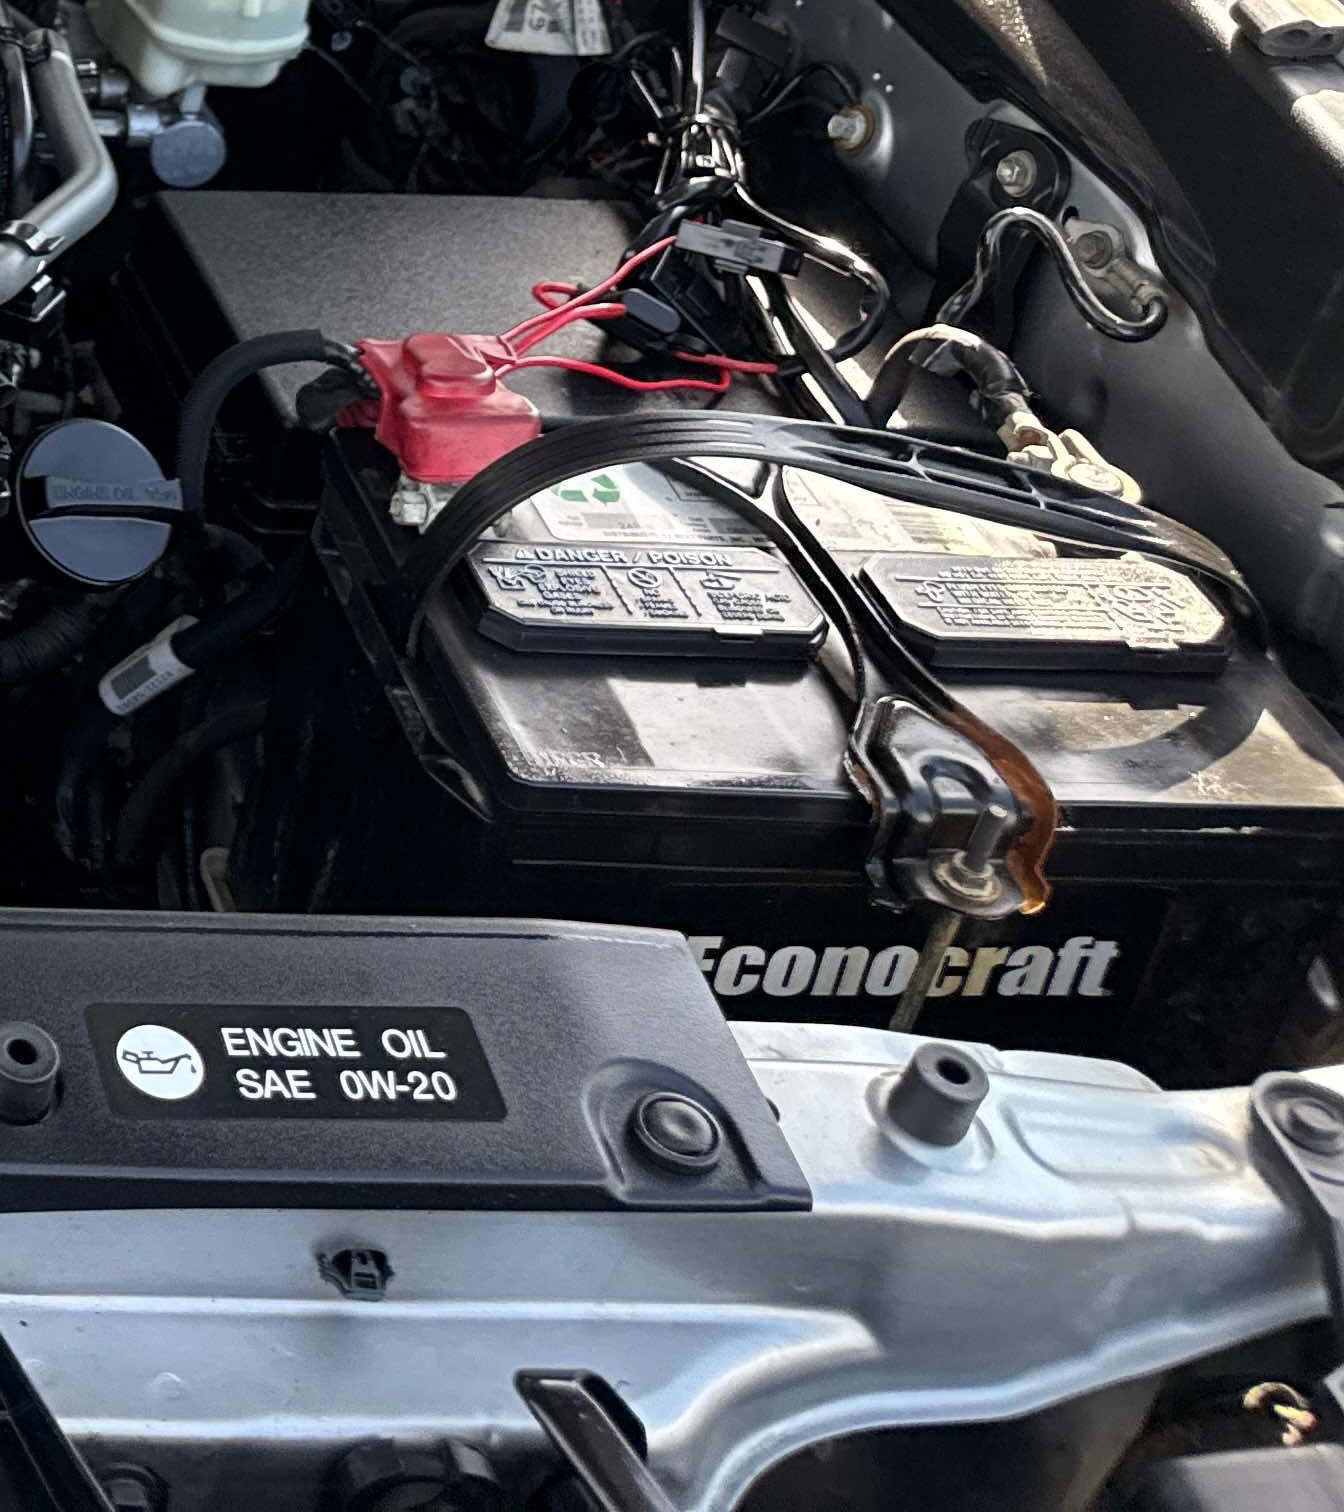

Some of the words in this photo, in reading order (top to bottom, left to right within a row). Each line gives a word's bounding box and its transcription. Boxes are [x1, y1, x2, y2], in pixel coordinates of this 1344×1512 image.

[534, 548, 627, 563] DANGER
[648, 551, 732, 567] POISON
[221, 1028, 361, 1059] ENGINE
[382, 1029, 447, 1060] OIL
[237, 1069, 315, 1100] SAE
[341, 1070, 458, 1102] 0W-20
